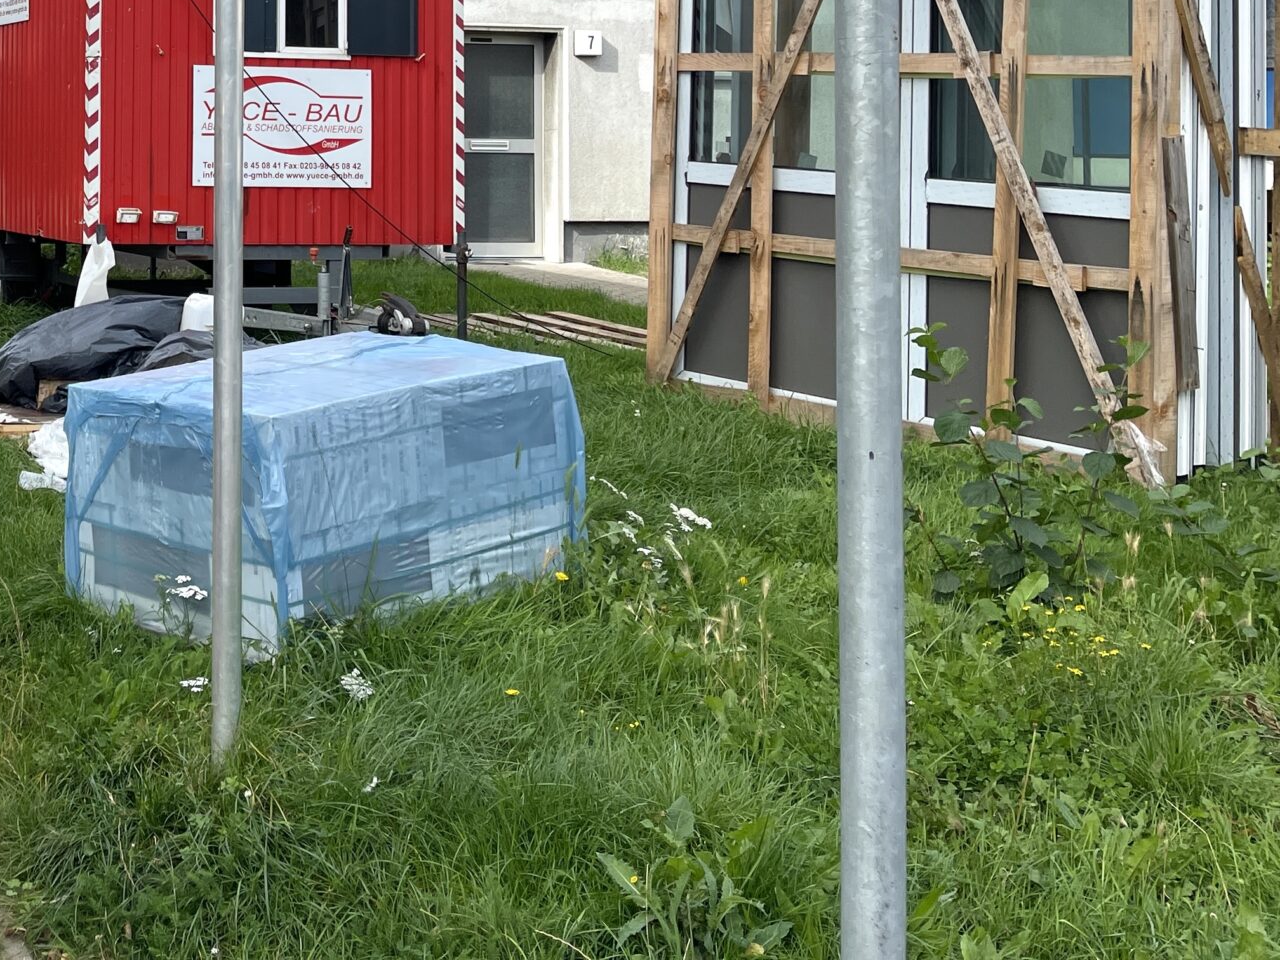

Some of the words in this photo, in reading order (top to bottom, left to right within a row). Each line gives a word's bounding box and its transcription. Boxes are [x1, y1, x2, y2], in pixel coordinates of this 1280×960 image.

[587, 35, 595, 50] 7
[203, 100, 280, 121] YCE
[305, 103, 363, 123] BAU
[246, 123, 252, 132] &
[254, 123, 363, 134] SCHADSTOFFSANIERUNG
[321, 140, 340, 149] GmbH
[341, 162, 351, 170] 08
[352, 162, 362, 170] 42
